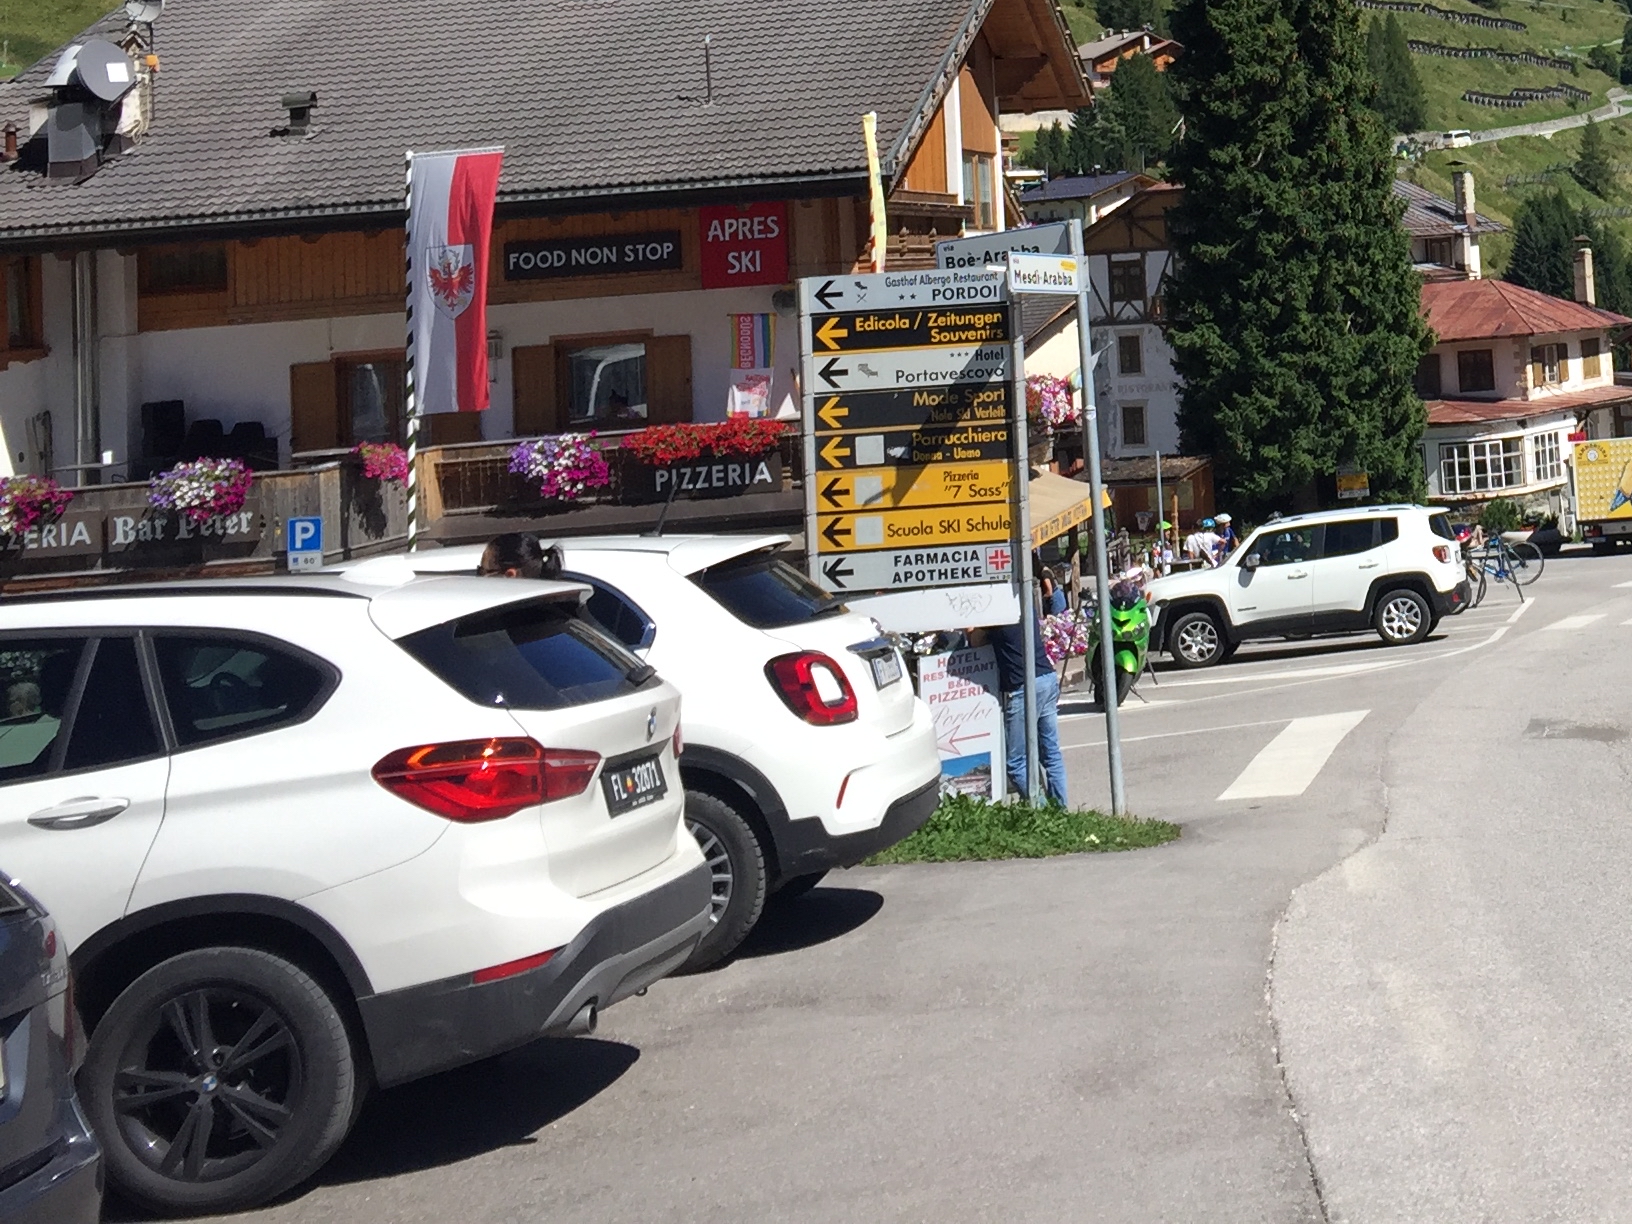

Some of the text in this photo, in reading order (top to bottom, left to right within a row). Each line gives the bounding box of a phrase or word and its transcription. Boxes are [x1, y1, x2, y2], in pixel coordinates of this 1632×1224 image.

[707, 216, 780, 242] APRES
[509, 242, 674, 270] FOOD NON STOP
[943, 244, 955, 253] via
[727, 250, 761, 274] SKI
[885, 271, 999, 288] Gasthof Albergo Restaurant
[932, 285, 998, 301] PORDOI
[855, 313, 910, 332] Edicola
[927, 312, 1003, 328] Zeitungen
[930, 326, 1004, 343] Souvenirs
[975, 347, 1005, 361] Hotel
[896, 367, 1005, 384] Portavescovo
[913, 387, 1005, 407] Mode Sport
[912, 427, 1008, 446] Parrucchiera
[655, 461, 773, 492] PIZZERIA
[943, 470, 980, 482] Pizzeria
[112, 515, 167, 546] Bar
[294, 521, 315, 549] P
[887, 520, 934, 538] Scuola
[939, 519, 961, 534] SKI
[966, 515, 1012, 533] Schule
[893, 549, 981, 568] FARMACIA
[892, 565, 983, 584] APOTHEKE
[937, 651, 980, 668] HOTEL
[923, 661, 995, 683] RESTAURANT
[947, 677, 971, 689] B&B
[929, 684, 990, 705] PIZZERIA
[611, 760, 661, 802] FL 32871
